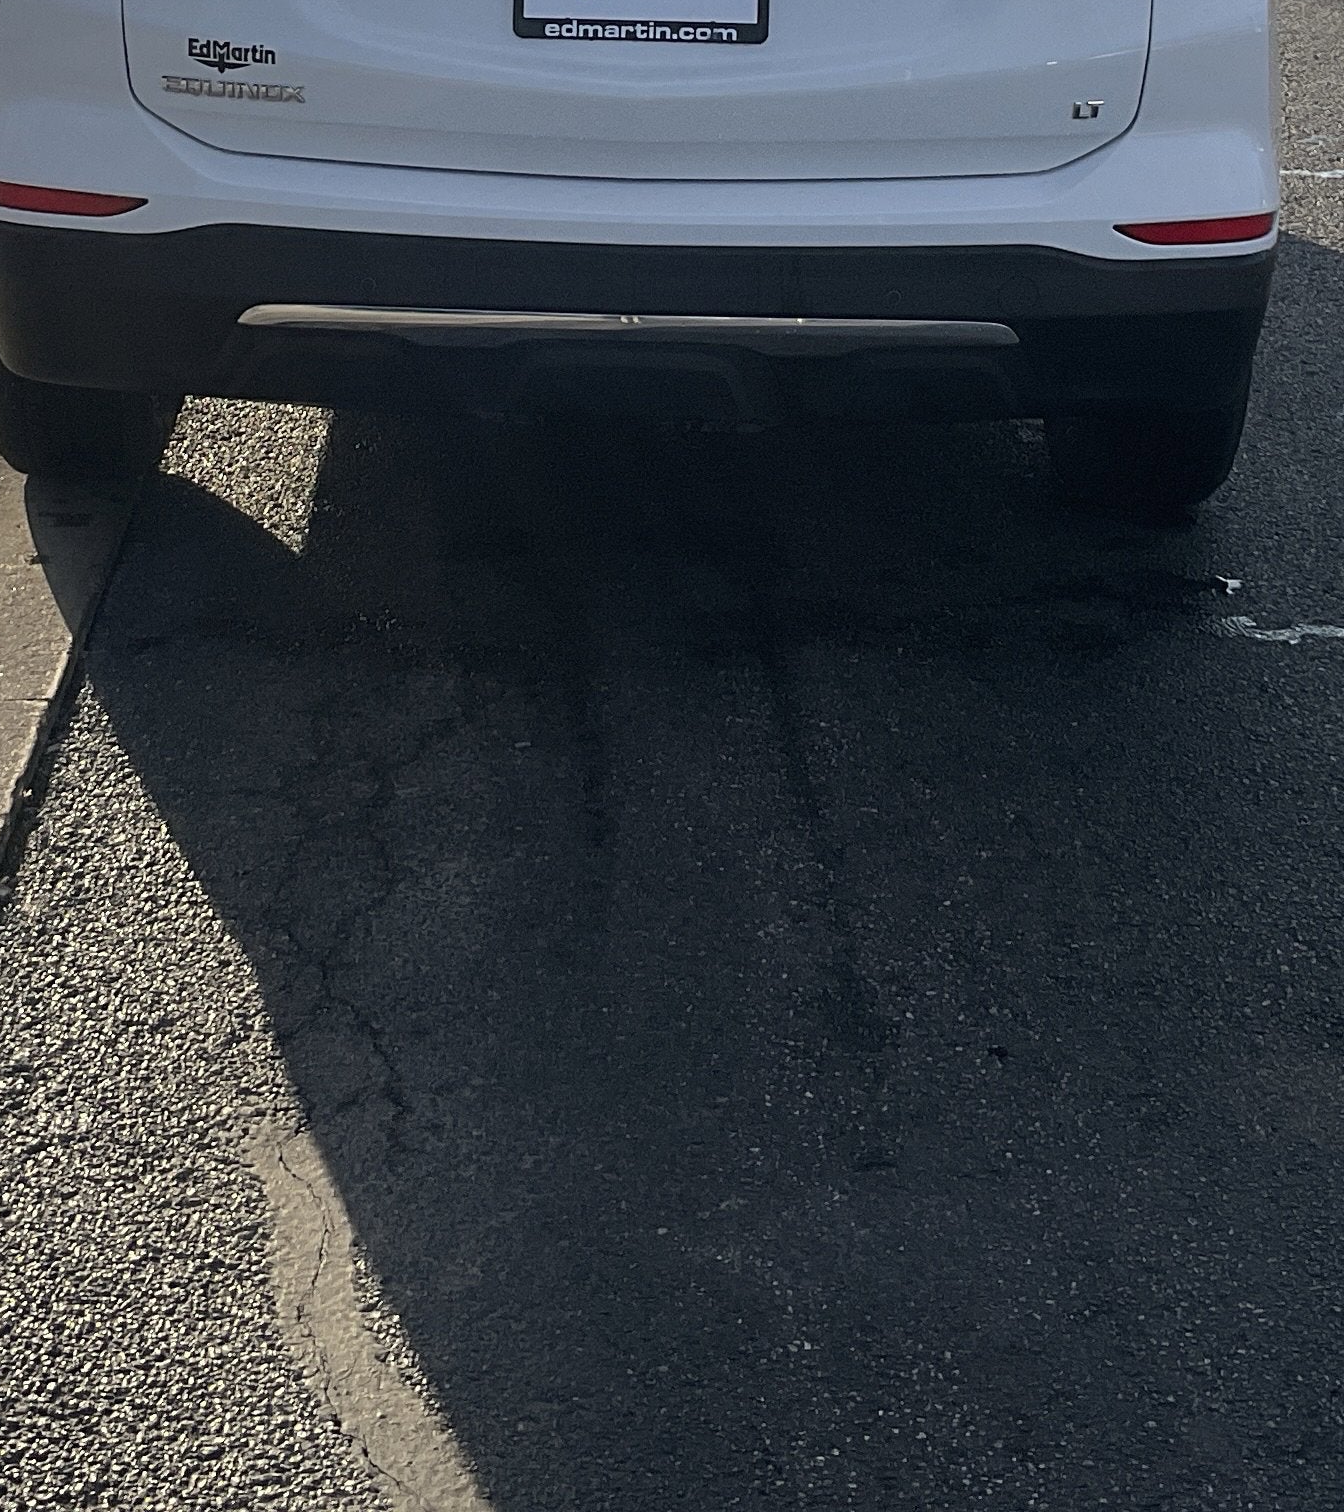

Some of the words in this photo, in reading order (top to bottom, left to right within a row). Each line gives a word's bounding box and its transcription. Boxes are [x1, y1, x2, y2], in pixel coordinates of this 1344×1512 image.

[544, 19, 738, 41] edmartin.com
[161, 75, 307, 104] EQUINOX
[1072, 99, 1105, 119] LT
